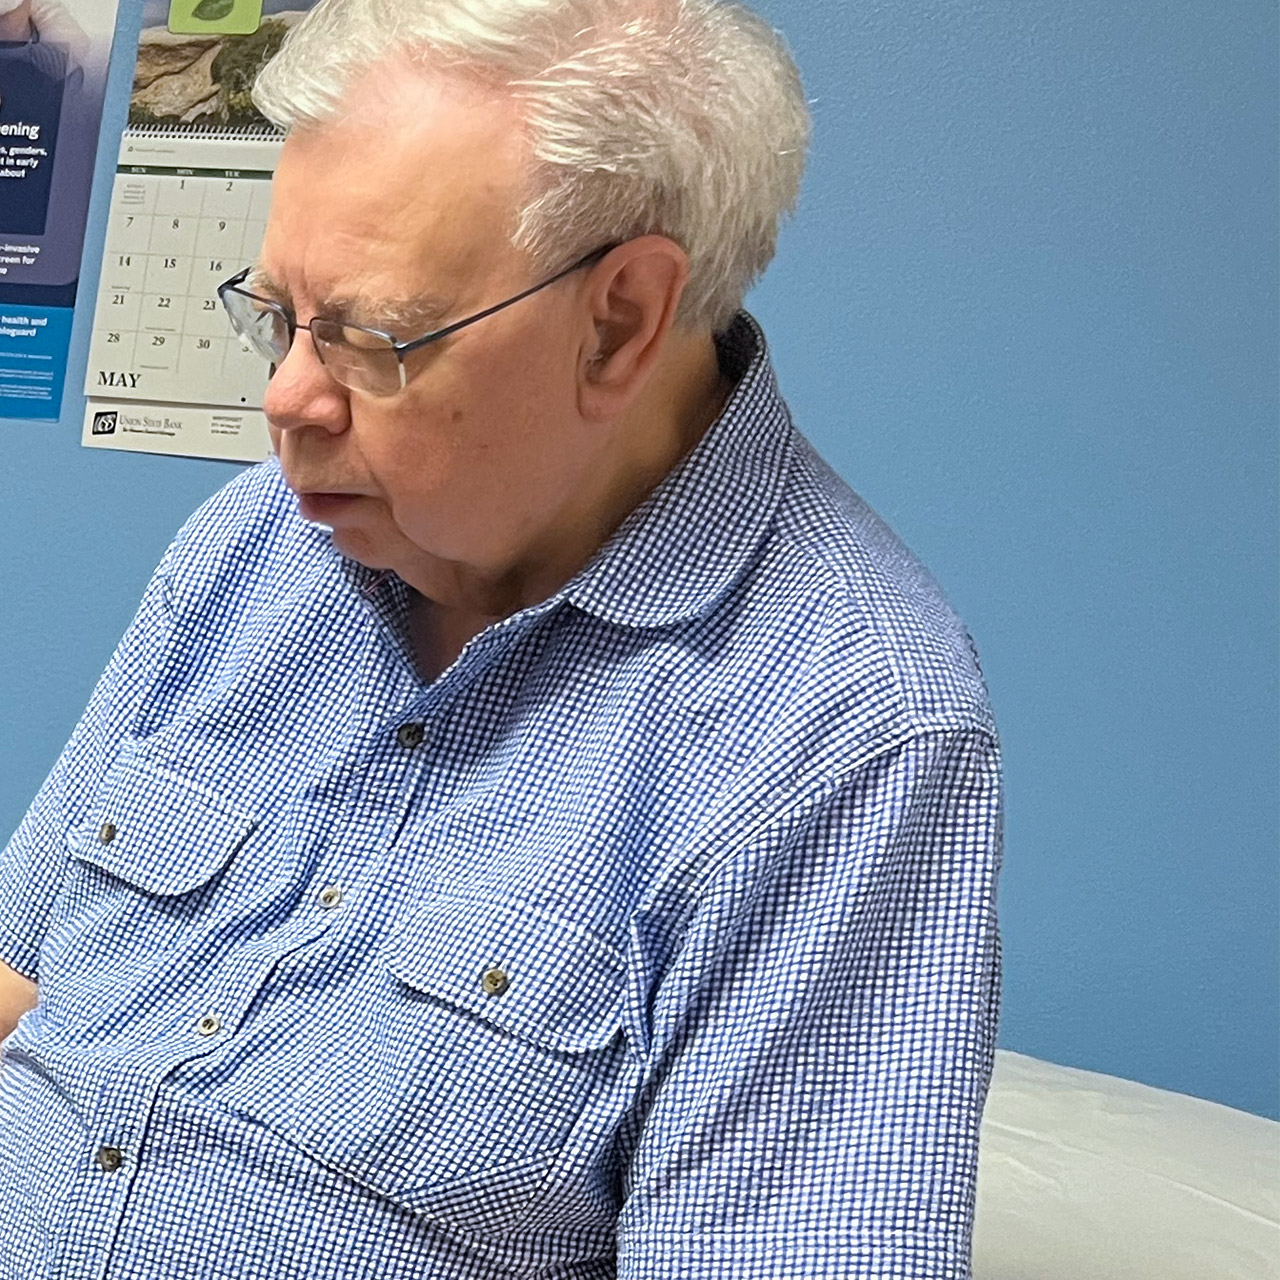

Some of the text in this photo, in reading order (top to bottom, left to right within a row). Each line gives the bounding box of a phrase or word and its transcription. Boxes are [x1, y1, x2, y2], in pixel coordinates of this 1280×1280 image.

[5, 157, 14, 165] in
[15, 158, 39, 169] early
[0, 168, 26, 178] about
[180, 179, 186, 190] 1
[226, 181, 233, 191] 2
[126, 216, 134, 227] 7
[171, 218, 180, 229] 8
[218, 221, 226, 232] 9
[22, 255, 35, 265] for
[119, 256, 131, 267] 14
[163, 258, 176, 269] 15
[209, 261, 222, 272] 16
[112, 294, 125, 305] 21
[157, 297, 171, 308] 22
[203, 300, 216, 311] 23
[107, 332, 120, 343] 28
[152, 336, 165, 346] 29
[197, 339, 210, 350] 30
[97, 371, 142, 388] MAY
